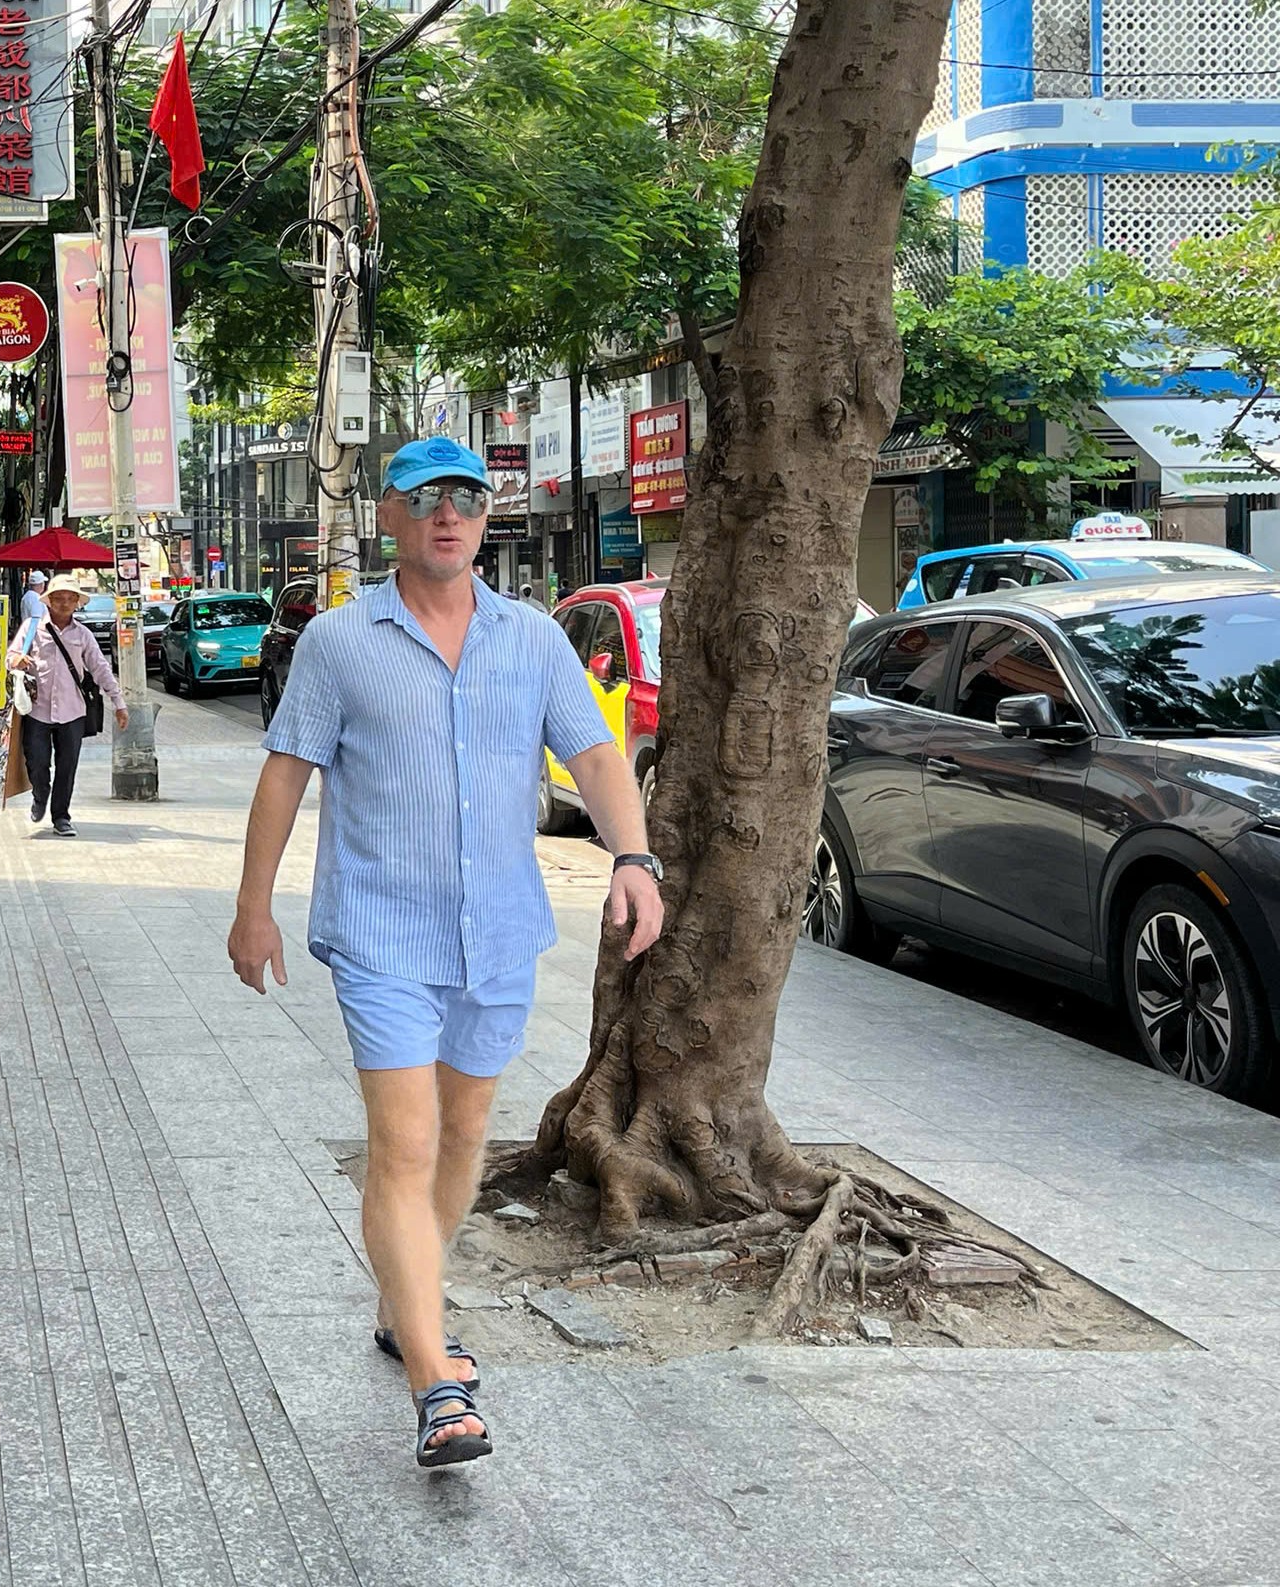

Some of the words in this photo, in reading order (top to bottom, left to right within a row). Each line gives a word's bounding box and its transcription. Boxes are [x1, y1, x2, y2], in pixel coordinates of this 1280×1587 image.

[248, 442, 289, 456] SANDALS
[1084, 524, 1123, 536] QUỐC
[1125, 523, 1144, 534] TẾ
